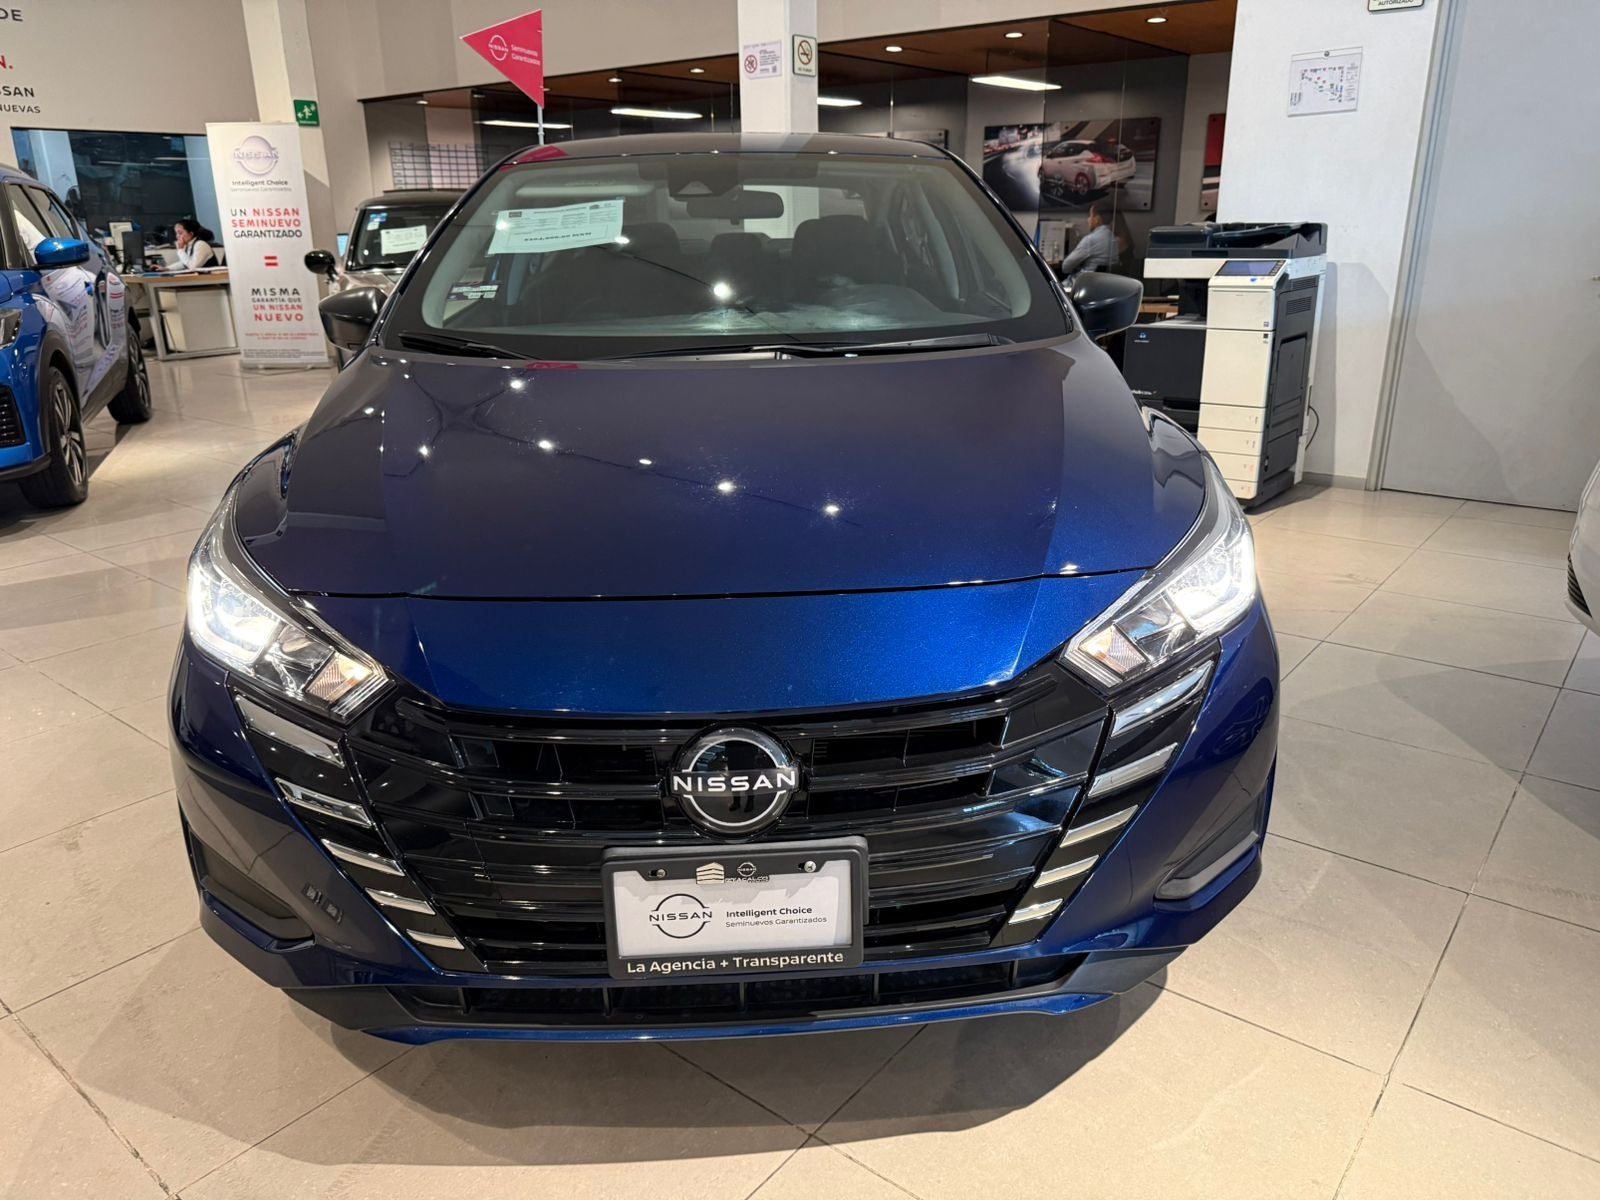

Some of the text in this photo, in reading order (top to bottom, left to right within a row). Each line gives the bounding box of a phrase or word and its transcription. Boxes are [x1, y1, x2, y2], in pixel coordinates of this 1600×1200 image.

[230, 208, 300, 217] UN NISSAN
[231, 219, 302, 228] SEMINUEVO
[233, 230, 303, 238] GARANTIZADO
[251, 288, 300, 296] MISMA
[254, 313, 304, 321] NUEVO
[672, 771, 796, 792] NISSAN
[649, 911, 713, 922] NISSAN
[726, 906, 813, 918] Intelligent Choice
[725, 916, 828, 928] Seminuevos Garantizados
[627, 962, 645, 973] La
[649, 958, 716, 974] Agencia
[732, 952, 844, 969] Transparente
